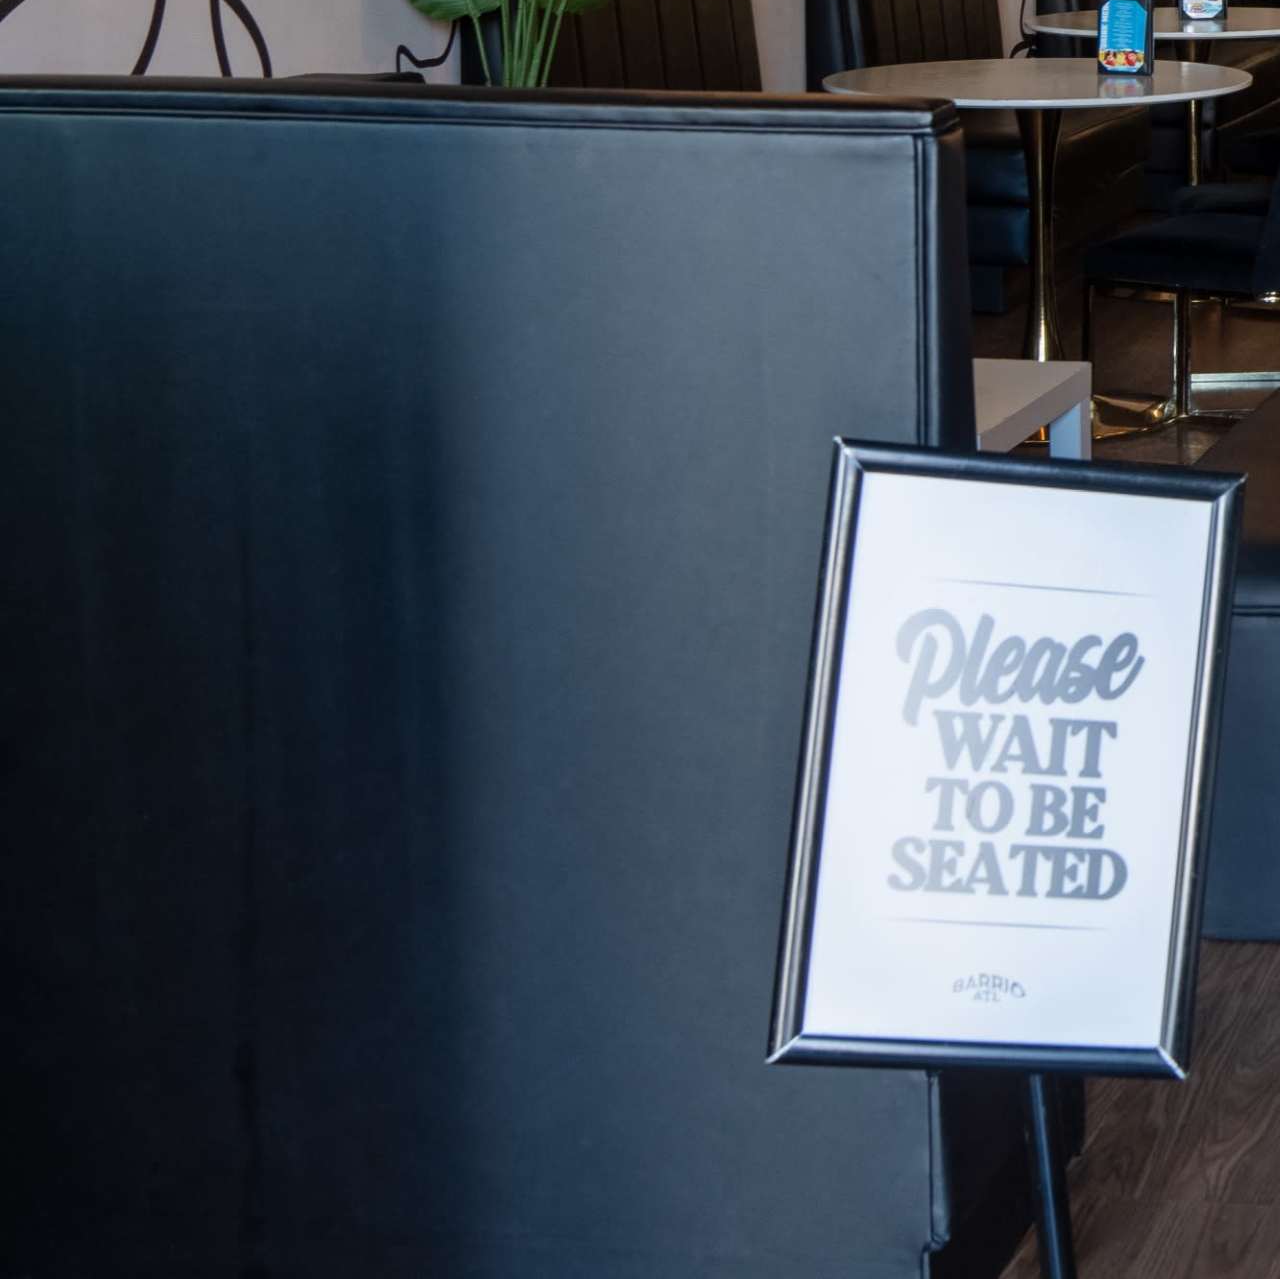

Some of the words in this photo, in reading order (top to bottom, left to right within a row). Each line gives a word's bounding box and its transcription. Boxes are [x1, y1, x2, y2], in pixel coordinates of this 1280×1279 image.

[896, 608, 1144, 726] Please
[933, 710, 1117, 778] WAIT
[926, 777, 1013, 833] TO
[1025, 784, 1106, 840] BE
[886, 835, 1127, 900] SEATED
[952, 972, 1026, 999] BARRIO
